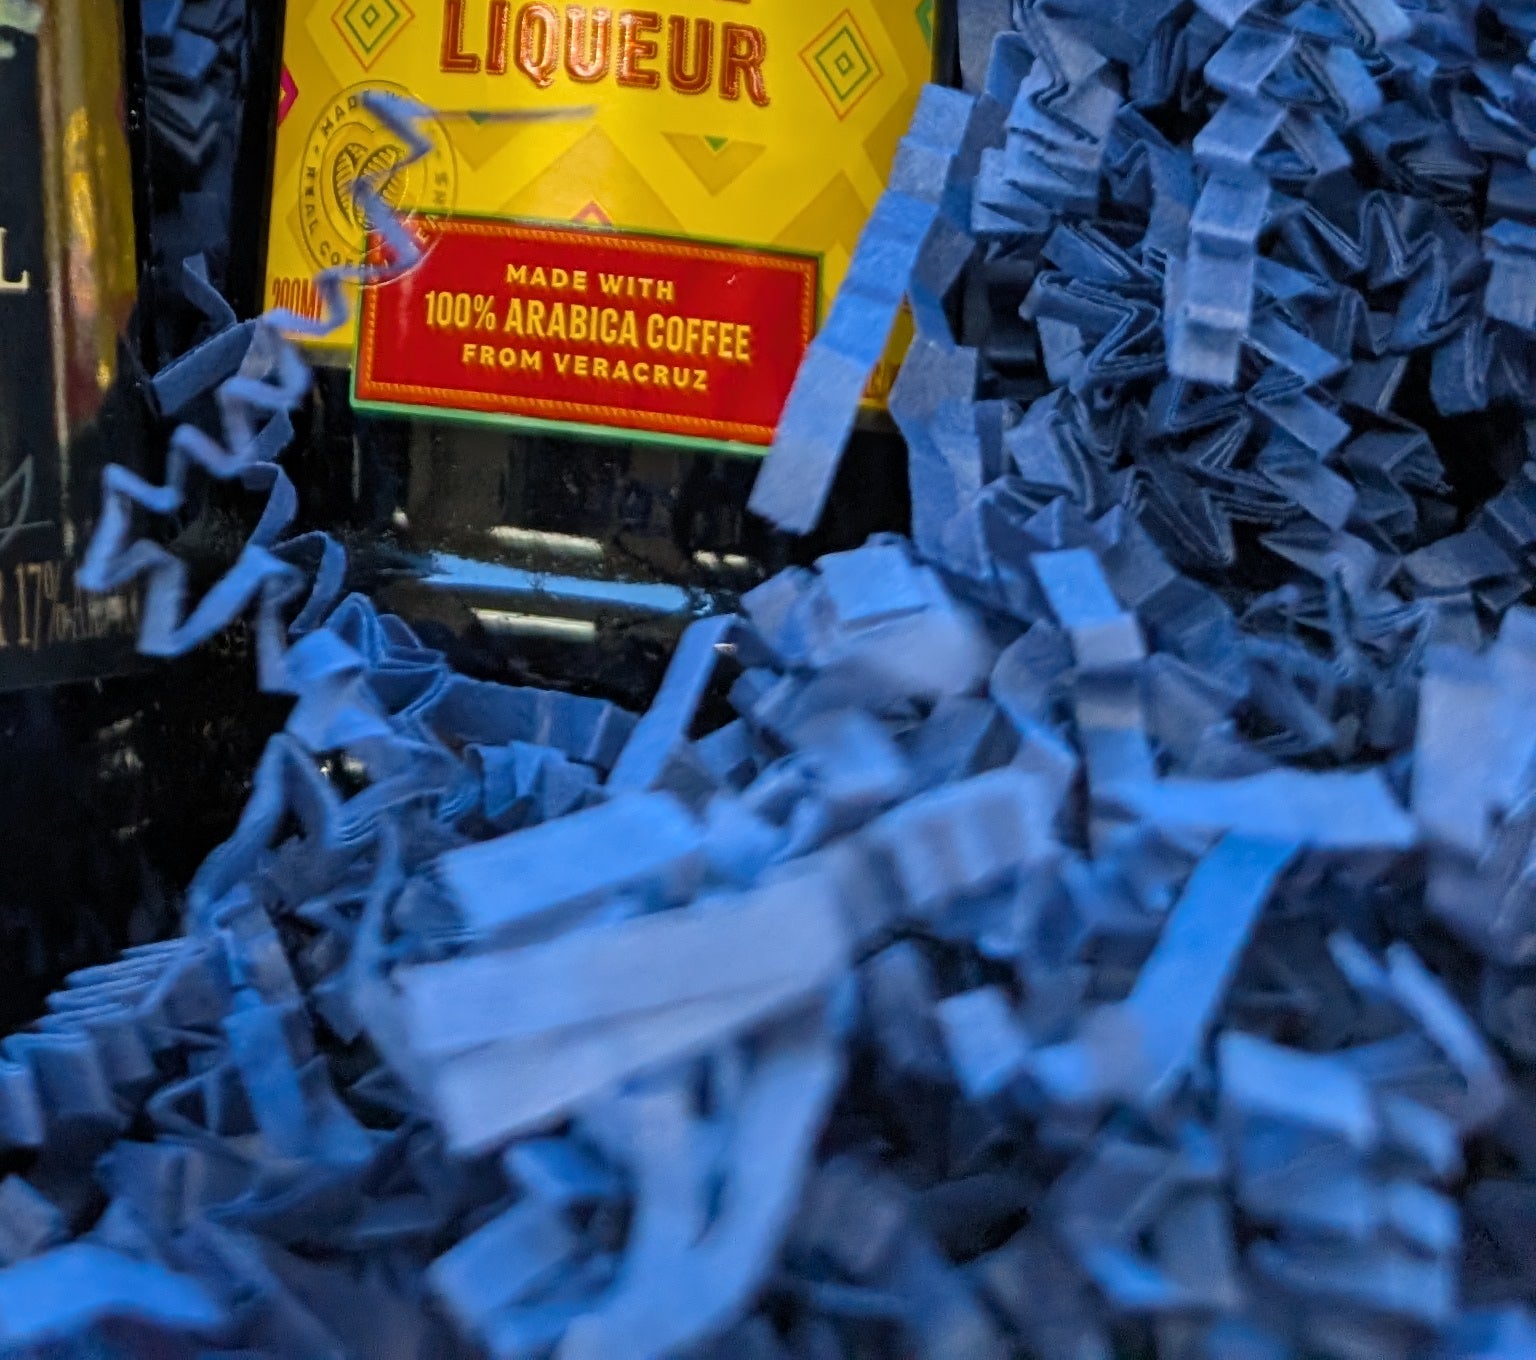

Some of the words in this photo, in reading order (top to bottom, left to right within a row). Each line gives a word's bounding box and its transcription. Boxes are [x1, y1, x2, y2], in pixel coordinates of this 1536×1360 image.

[321, 89, 370, 137] MAD
[506, 263, 588, 293] MADE
[599, 272, 675, 301] WITH
[425, 290, 497, 331] 100%
[504, 297, 639, 349] ARABICA
[646, 313, 752, 362] COFFEE
[462, 342, 543, 372] FROM
[553, 352, 709, 392] VERACRUZ
